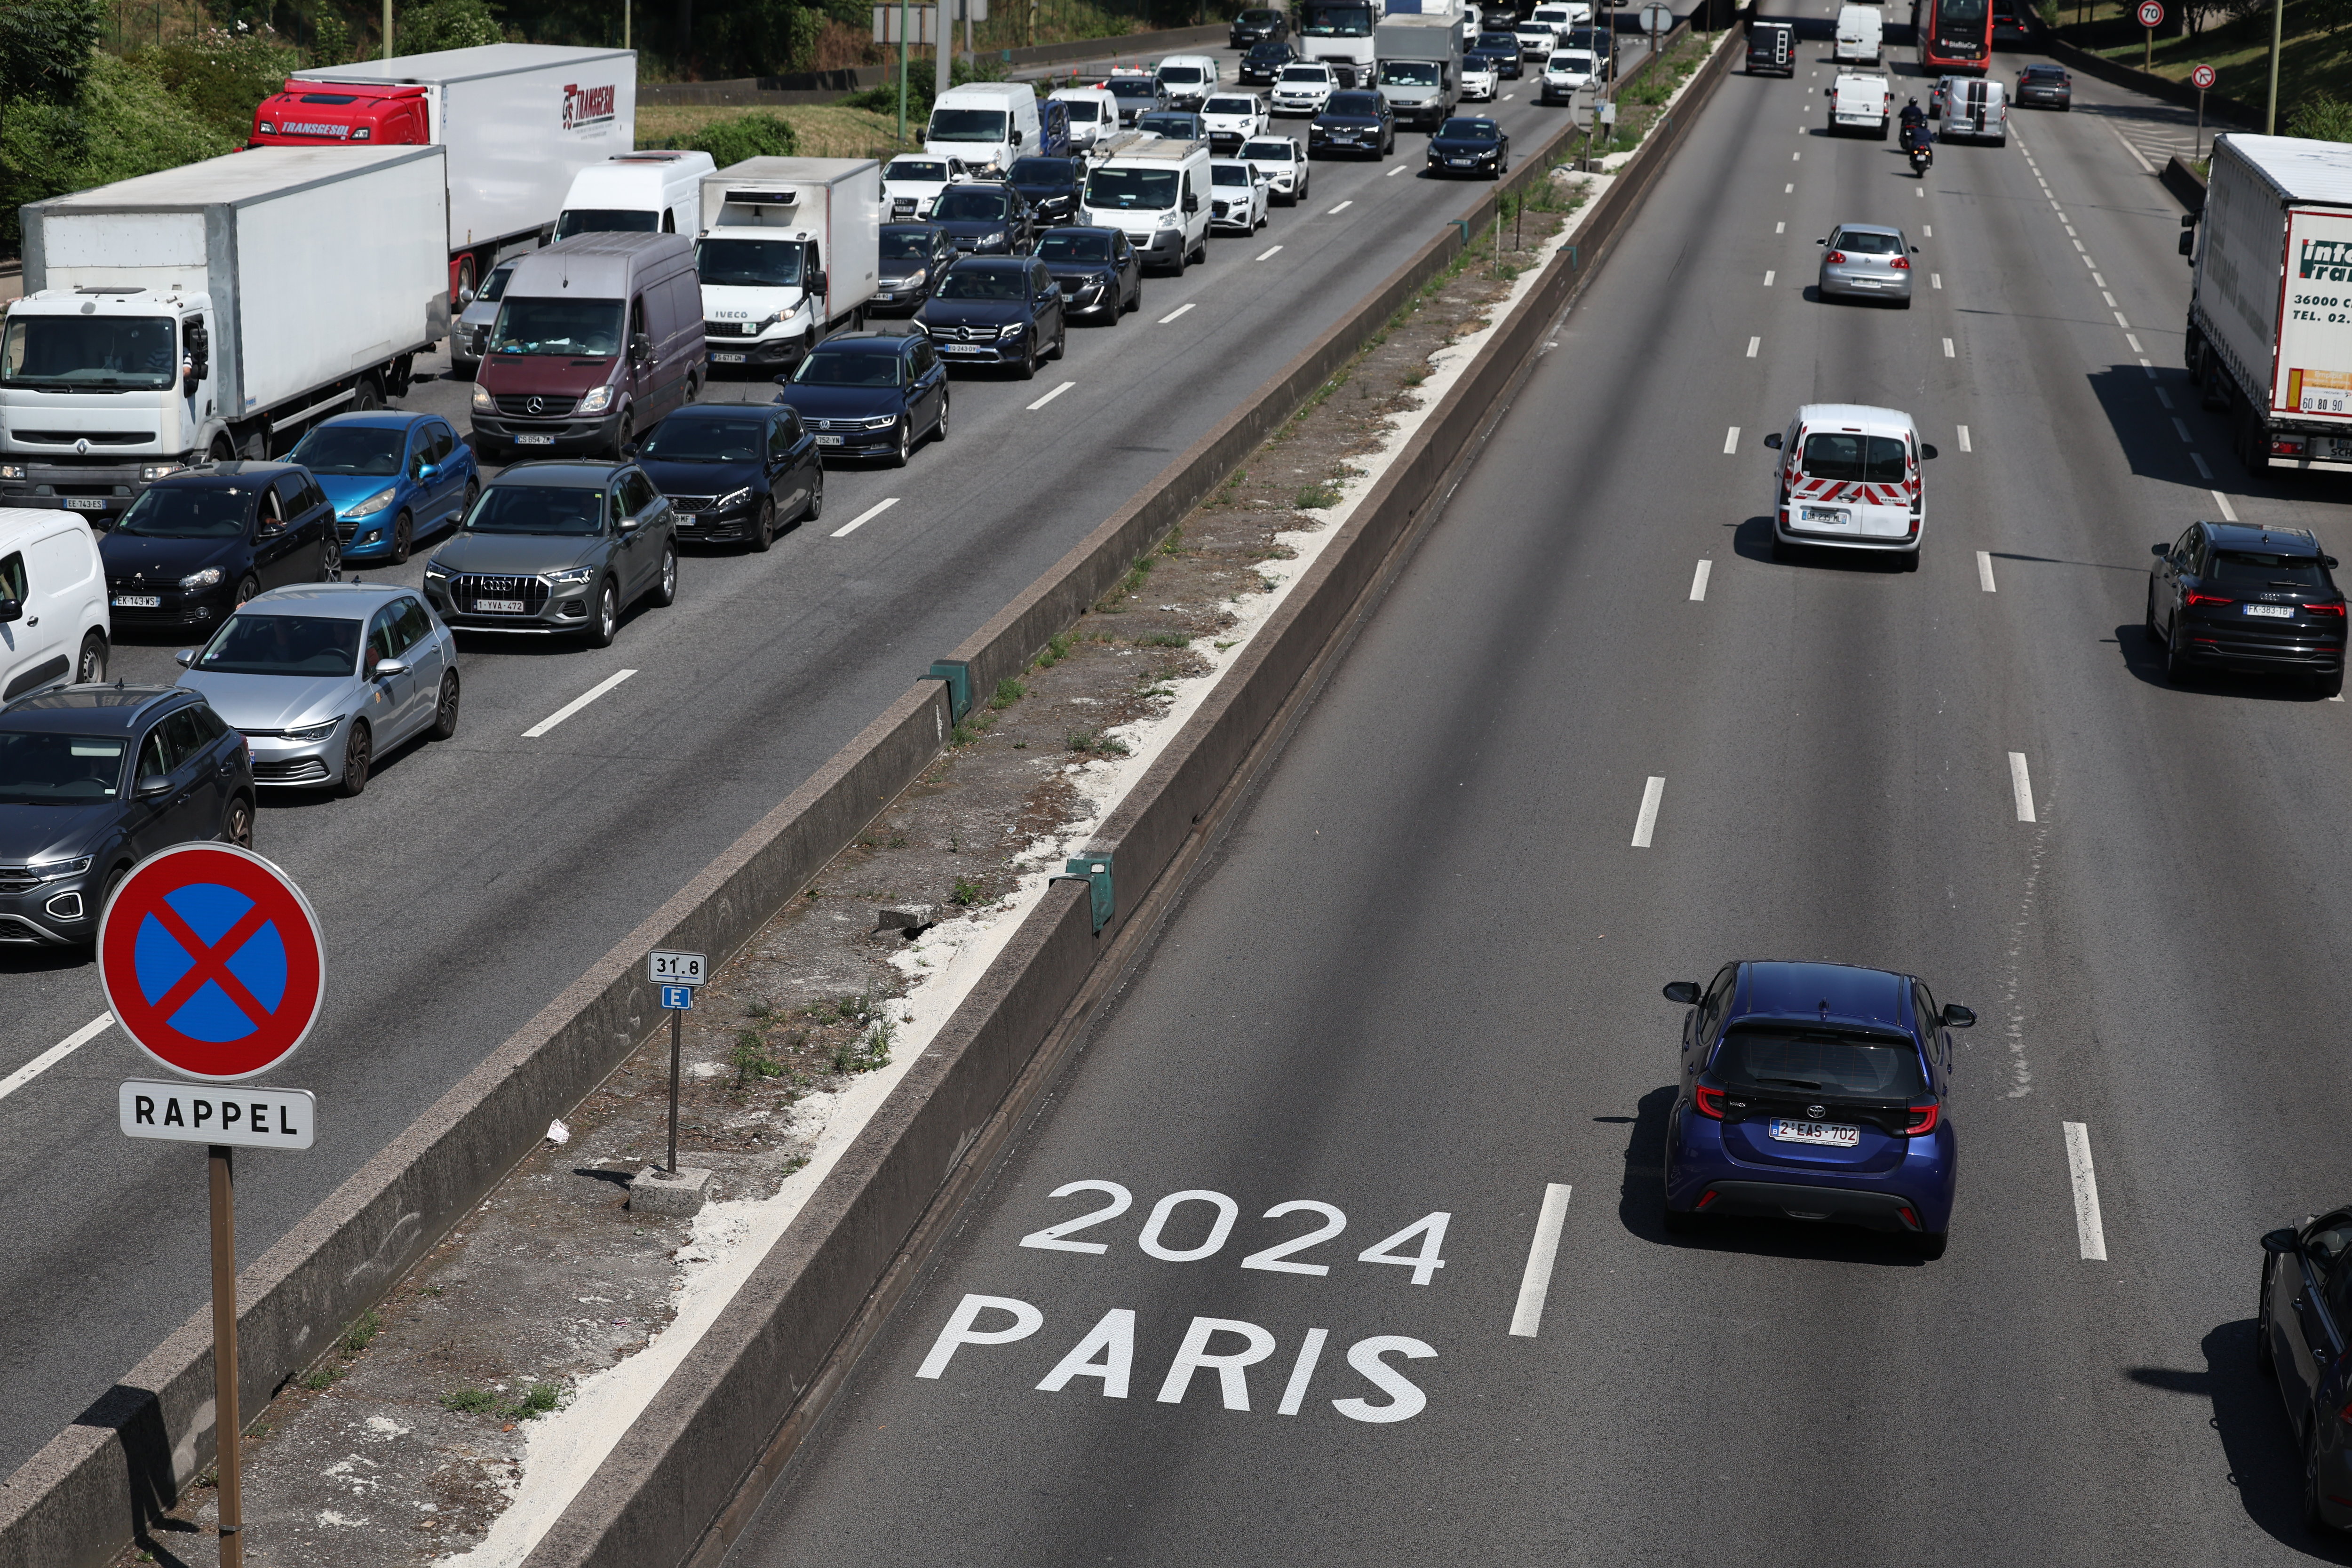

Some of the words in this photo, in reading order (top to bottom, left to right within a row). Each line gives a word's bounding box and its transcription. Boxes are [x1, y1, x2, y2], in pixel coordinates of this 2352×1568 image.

[2145, 8, 2158, 18] 70
[1949, 40, 1977, 49] BlaBlaCar
[576, 85, 615, 120] TRANSGESOL
[281, 122, 350, 135] TRANSGESOL
[2294, 294, 2337, 306] 36000
[2293, 310, 2320, 321] TEL.
[2303, 397, 2313, 409] 60
[2318, 398, 2327, 410] 80
[2332, 399, 2343, 411] 90
[479, 601, 522, 610] 1-YVA-472
[2249, 605, 2288, 615] FK-383-TB
[657, 958, 699, 975] 31.8
[671, 989, 682, 1006] E
[135, 1095, 297, 1135] RAPPEL
[1018, 1180, 1451, 1286] 2024
[914, 1294, 1439, 1423] PARIS
